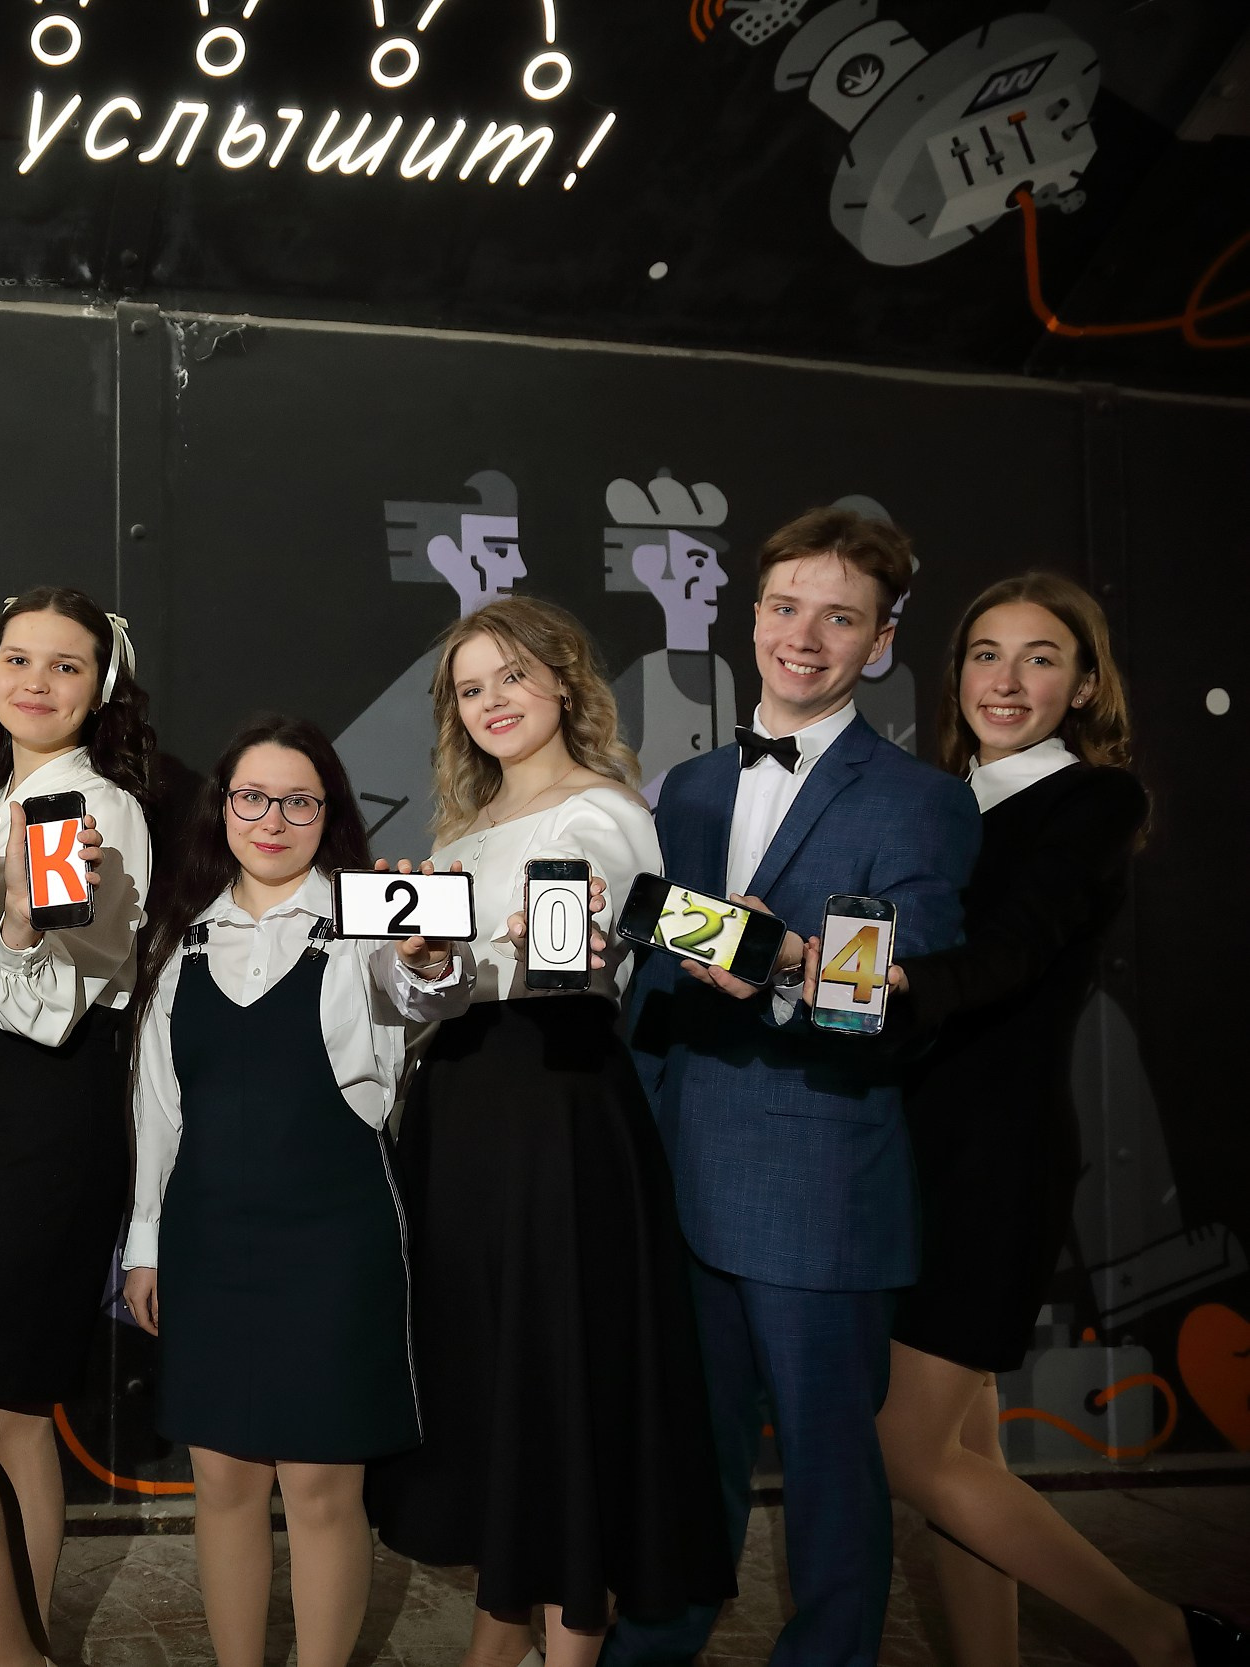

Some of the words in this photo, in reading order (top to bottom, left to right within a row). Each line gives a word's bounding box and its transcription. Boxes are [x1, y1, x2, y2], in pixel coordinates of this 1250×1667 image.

[18, 90, 617, 190] услышит!
[384, 879, 422, 935] 2
[532, 887, 585, 964] 0
[669, 891, 737, 960] 2
[821, 925, 887, 1004] 4
